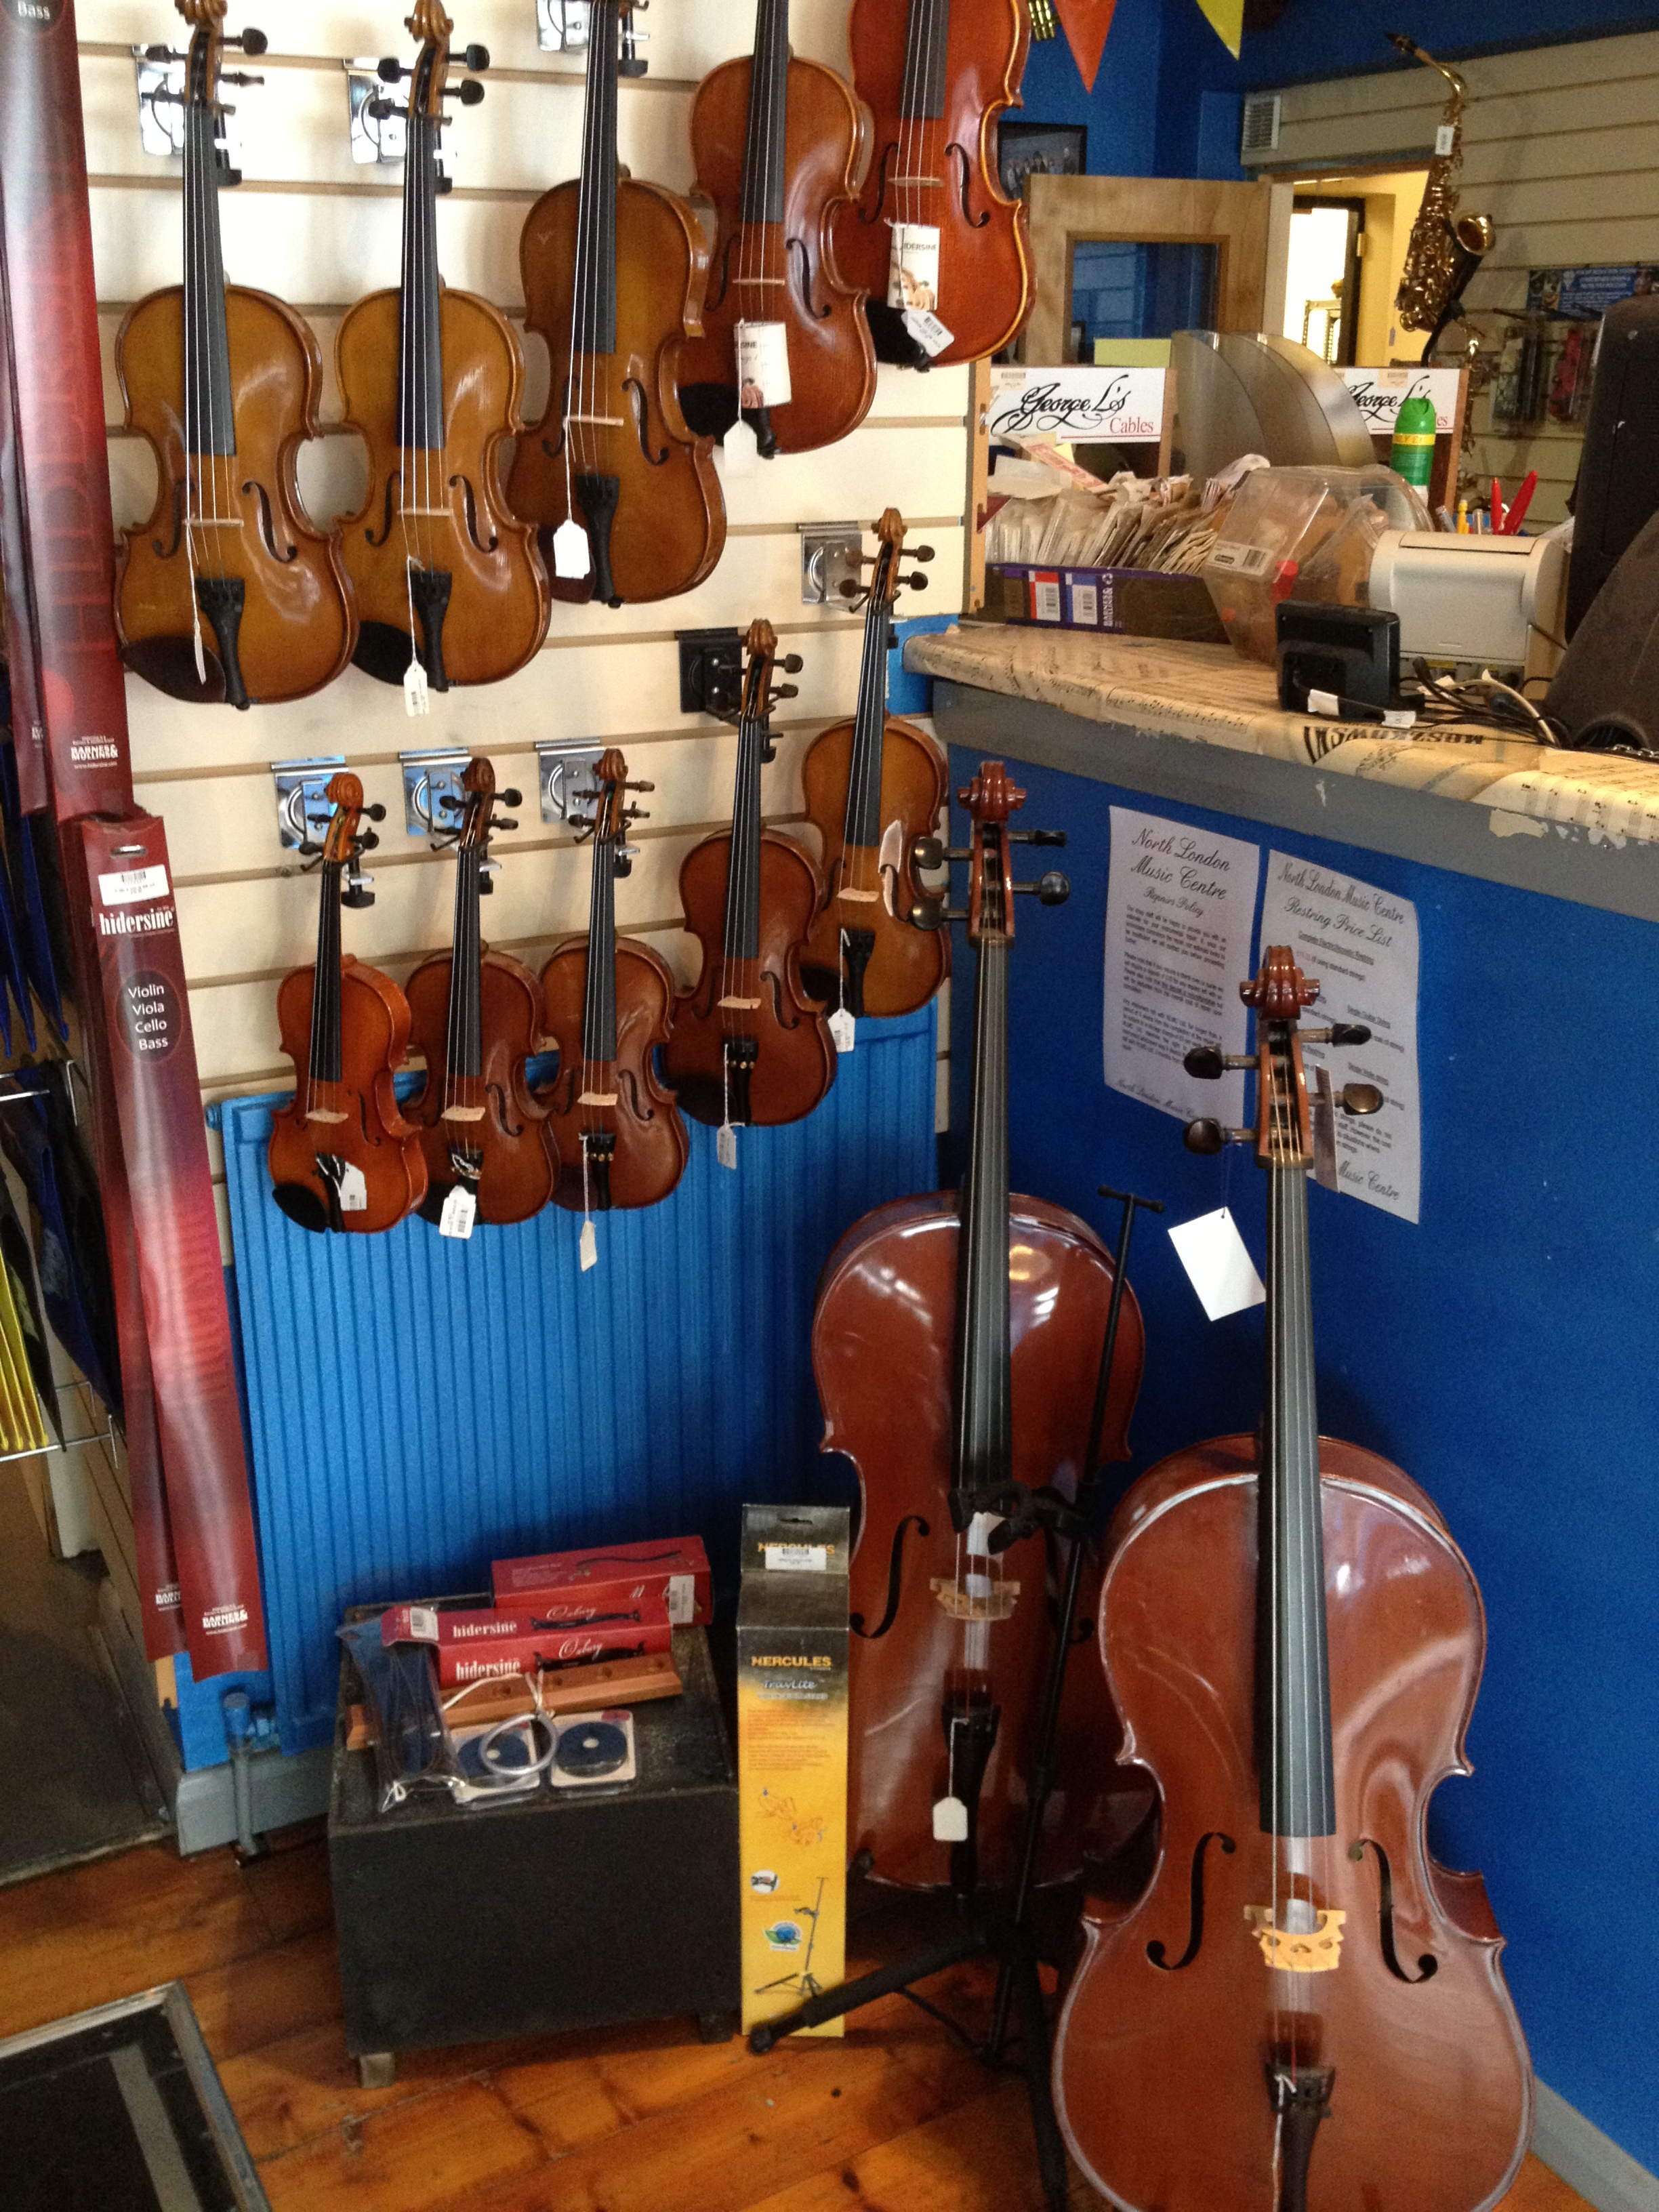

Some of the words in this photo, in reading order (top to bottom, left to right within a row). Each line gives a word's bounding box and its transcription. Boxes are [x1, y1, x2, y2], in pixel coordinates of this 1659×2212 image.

[18, 0, 51, 20] Bass
[892, 243, 937, 251] IDERSINE
[990, 382, 1092, 436] George
[1109, 417, 1155, 434] Cables
[1132, 828, 1176, 855] North
[1174, 838, 1231, 872] London
[1130, 855, 1173, 883] Music
[1180, 866, 1227, 900] Centre
[1143, 886, 1175, 905] Repairs
[1176, 897, 1205, 918] Policy
[1277, 861, 1307, 888] North
[1305, 869, 1342, 901] London
[1341, 884, 1370, 912] Music
[1372, 893, 1405, 924] Centre
[99, 907, 174, 935] hidersine
[1284, 897, 1332, 929] Restring
[1333, 914, 1365, 938] Price
[1366, 924, 1393, 947] List
[127, 984, 165, 999] Violin
[132, 1001, 165, 1016] Viola
[135, 1018, 167, 1033] Cello
[139, 1037, 169, 1050] Bass
[1338, 1160, 1364, 1185] Music
[1368, 1170, 1400, 1201] Centre
[452, 1620, 517, 1638] hidersine
[455, 1658, 520, 1681] hidersine
[751, 1655, 833, 1668] HERCULES
